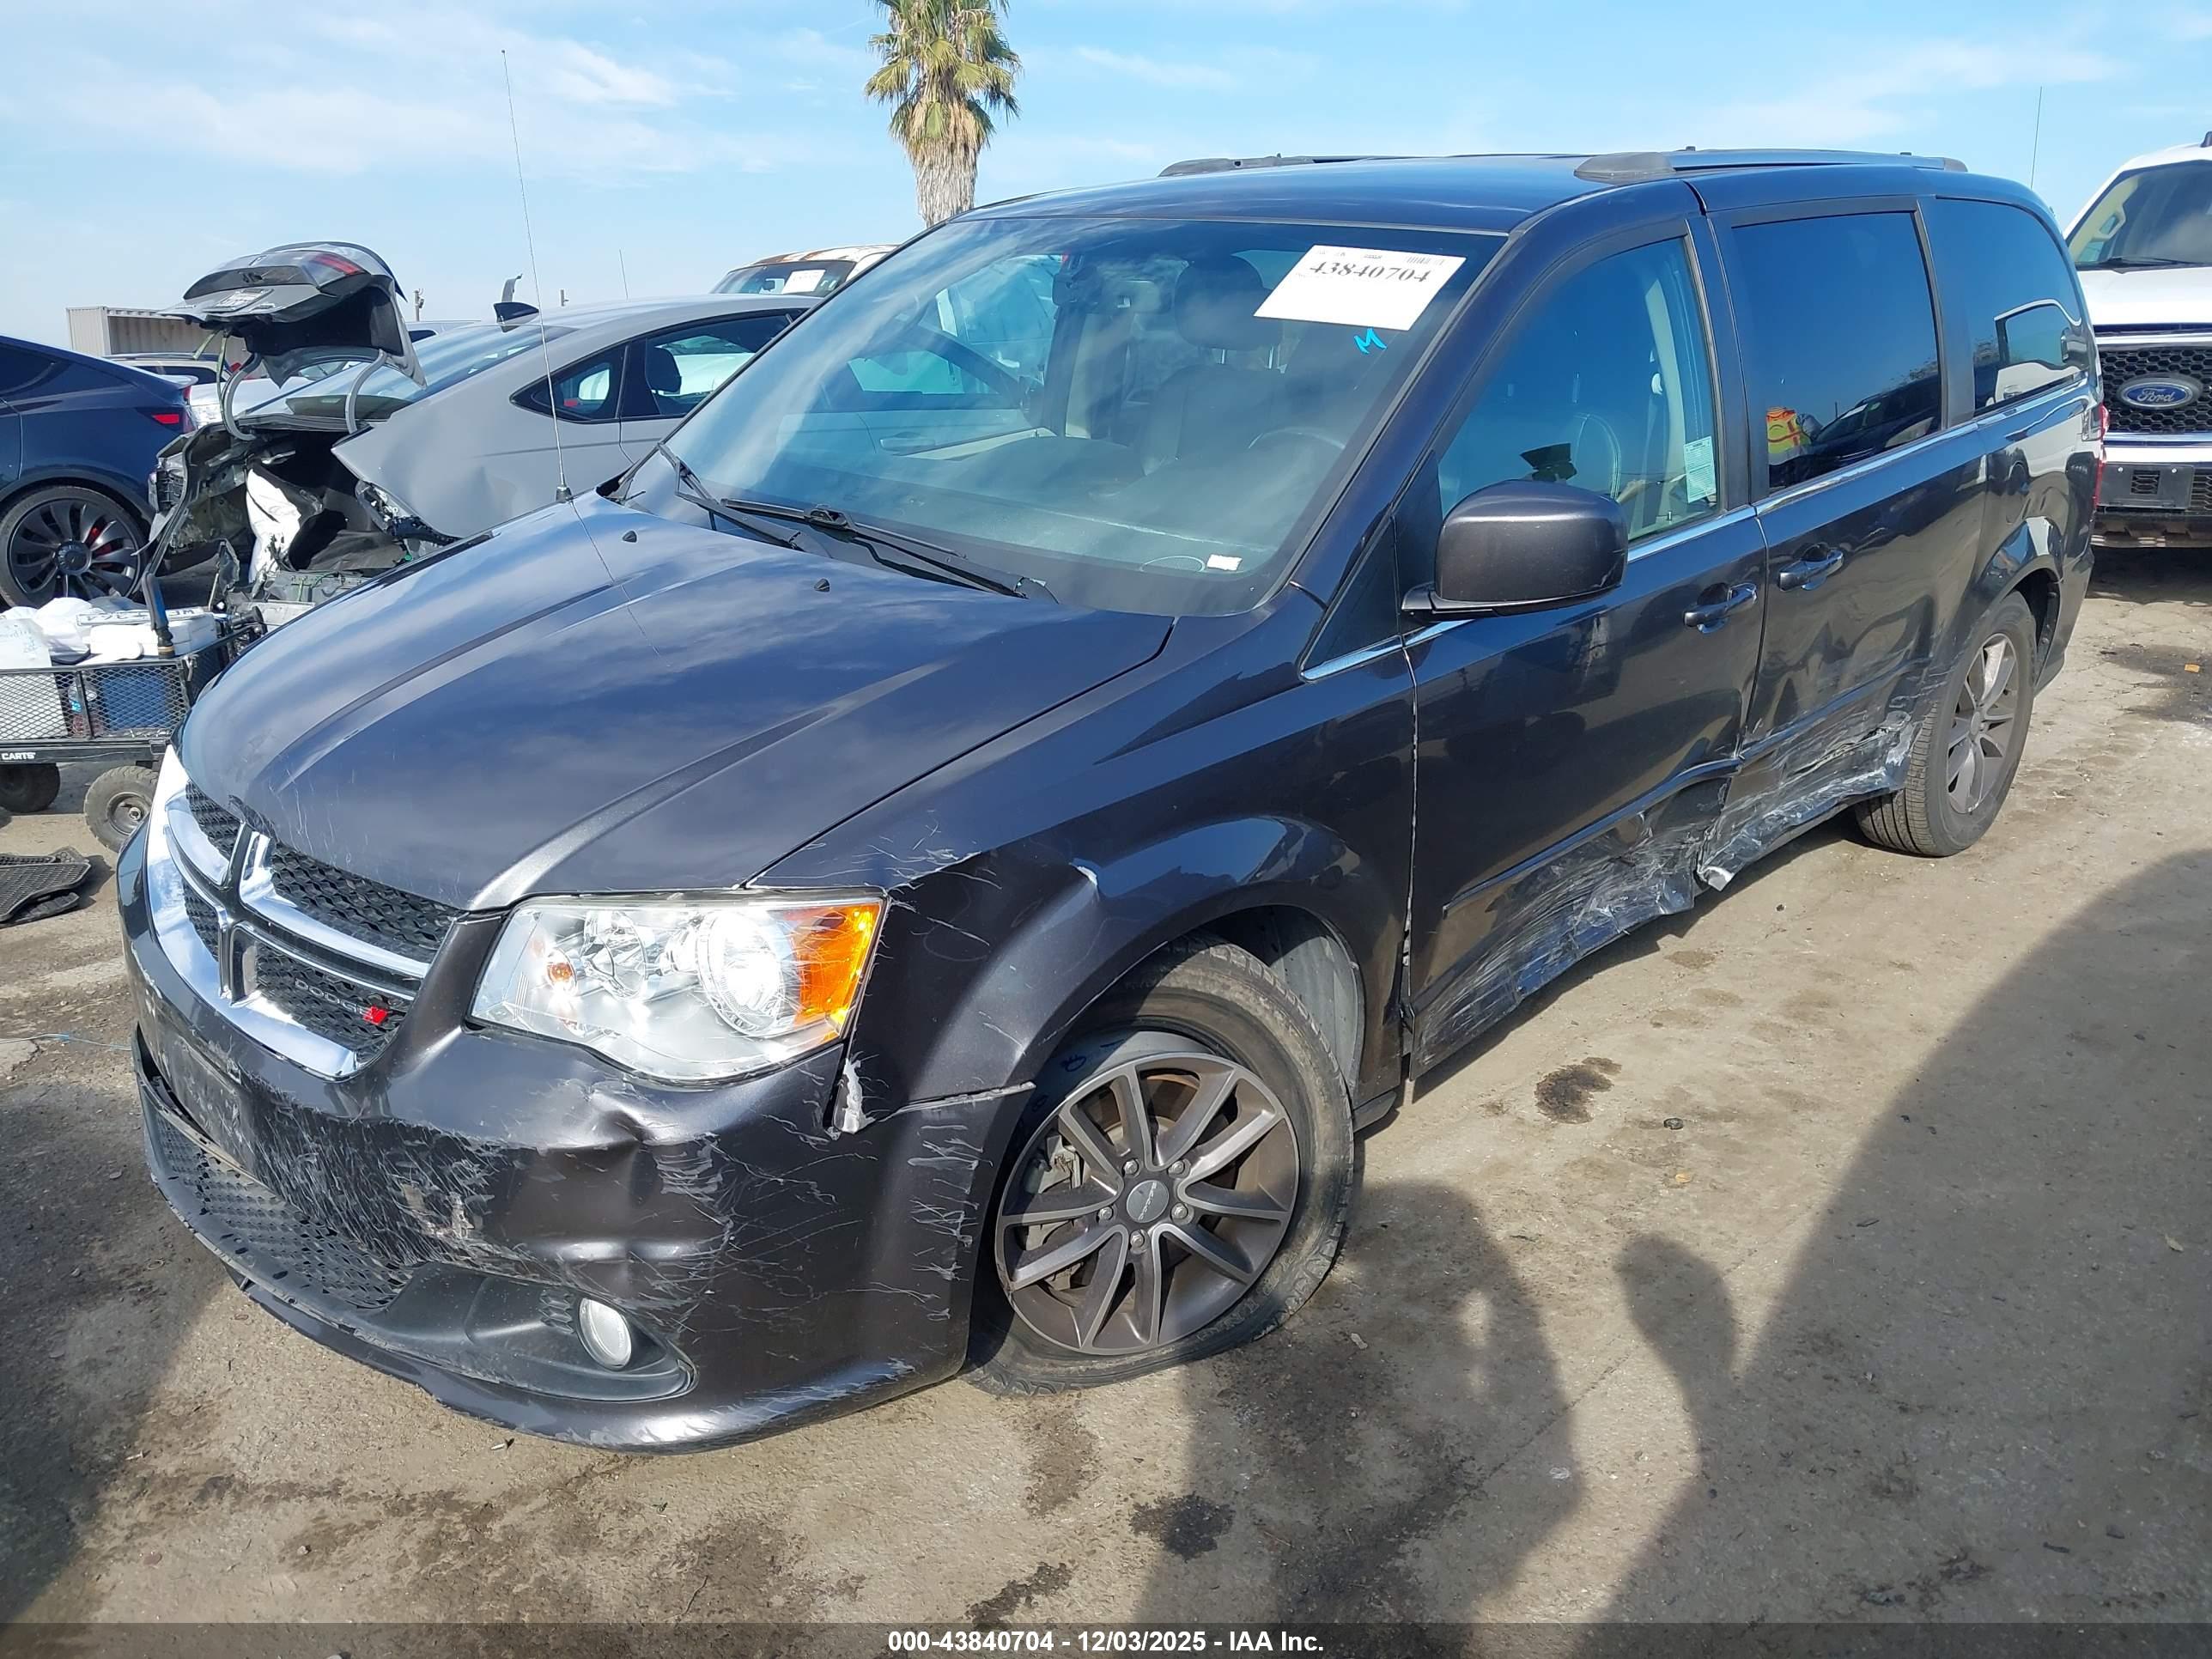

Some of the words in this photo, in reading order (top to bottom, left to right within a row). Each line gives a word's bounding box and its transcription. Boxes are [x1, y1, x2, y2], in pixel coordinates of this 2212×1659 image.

[1310, 260, 1431, 283] 43840704
[2136, 387, 2176, 403] Ford
[1, 751, 36, 761] CARTS
[295, 977, 370, 1018] DODGE
